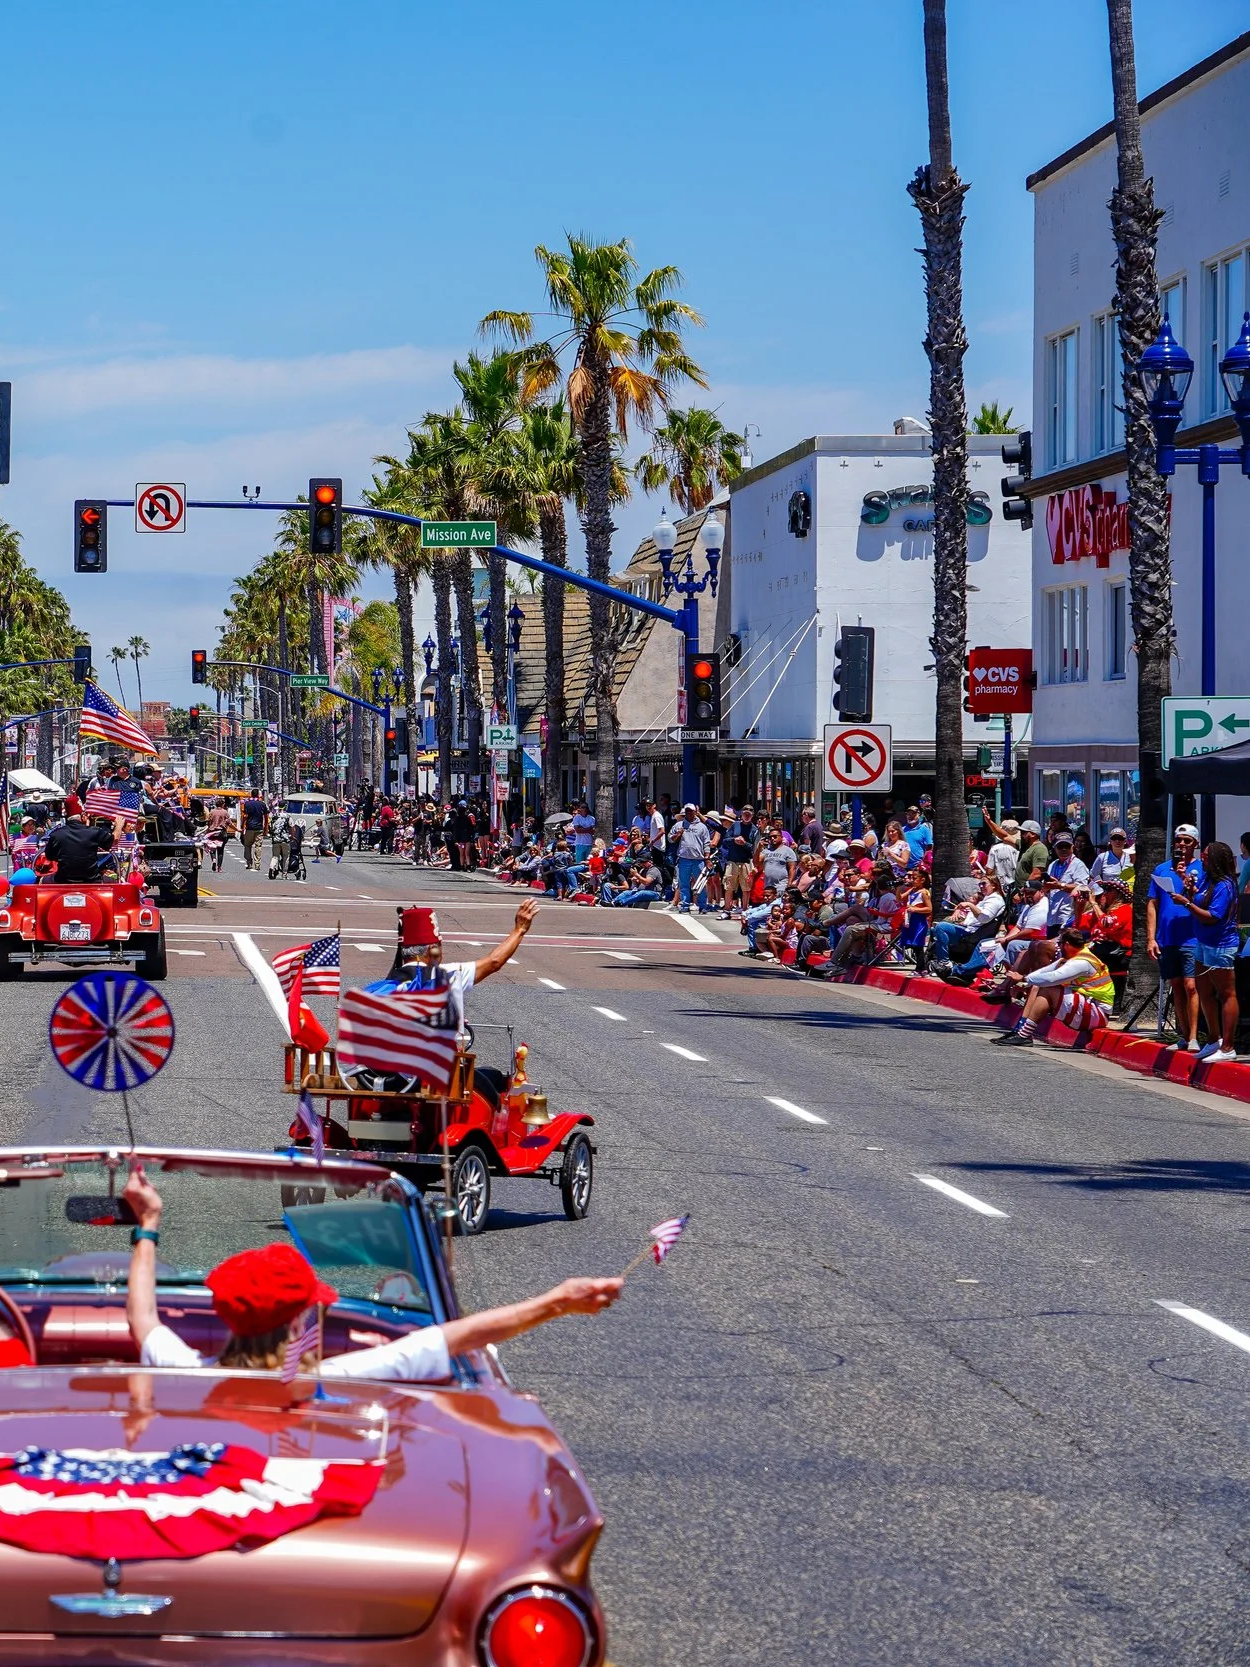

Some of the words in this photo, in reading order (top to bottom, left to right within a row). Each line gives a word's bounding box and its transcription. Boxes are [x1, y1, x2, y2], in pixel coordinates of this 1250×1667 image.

[903, 519, 935, 532] CAF
[426, 528, 467, 541] Mission
[470, 528, 491, 541] Ave
[987, 666, 1020, 682] CVS
[317, 677, 328, 686] Way
[974, 684, 1018, 696] pharmacy
[697, 731, 714, 739] WAY
[966, 775, 997, 786] OPEN
